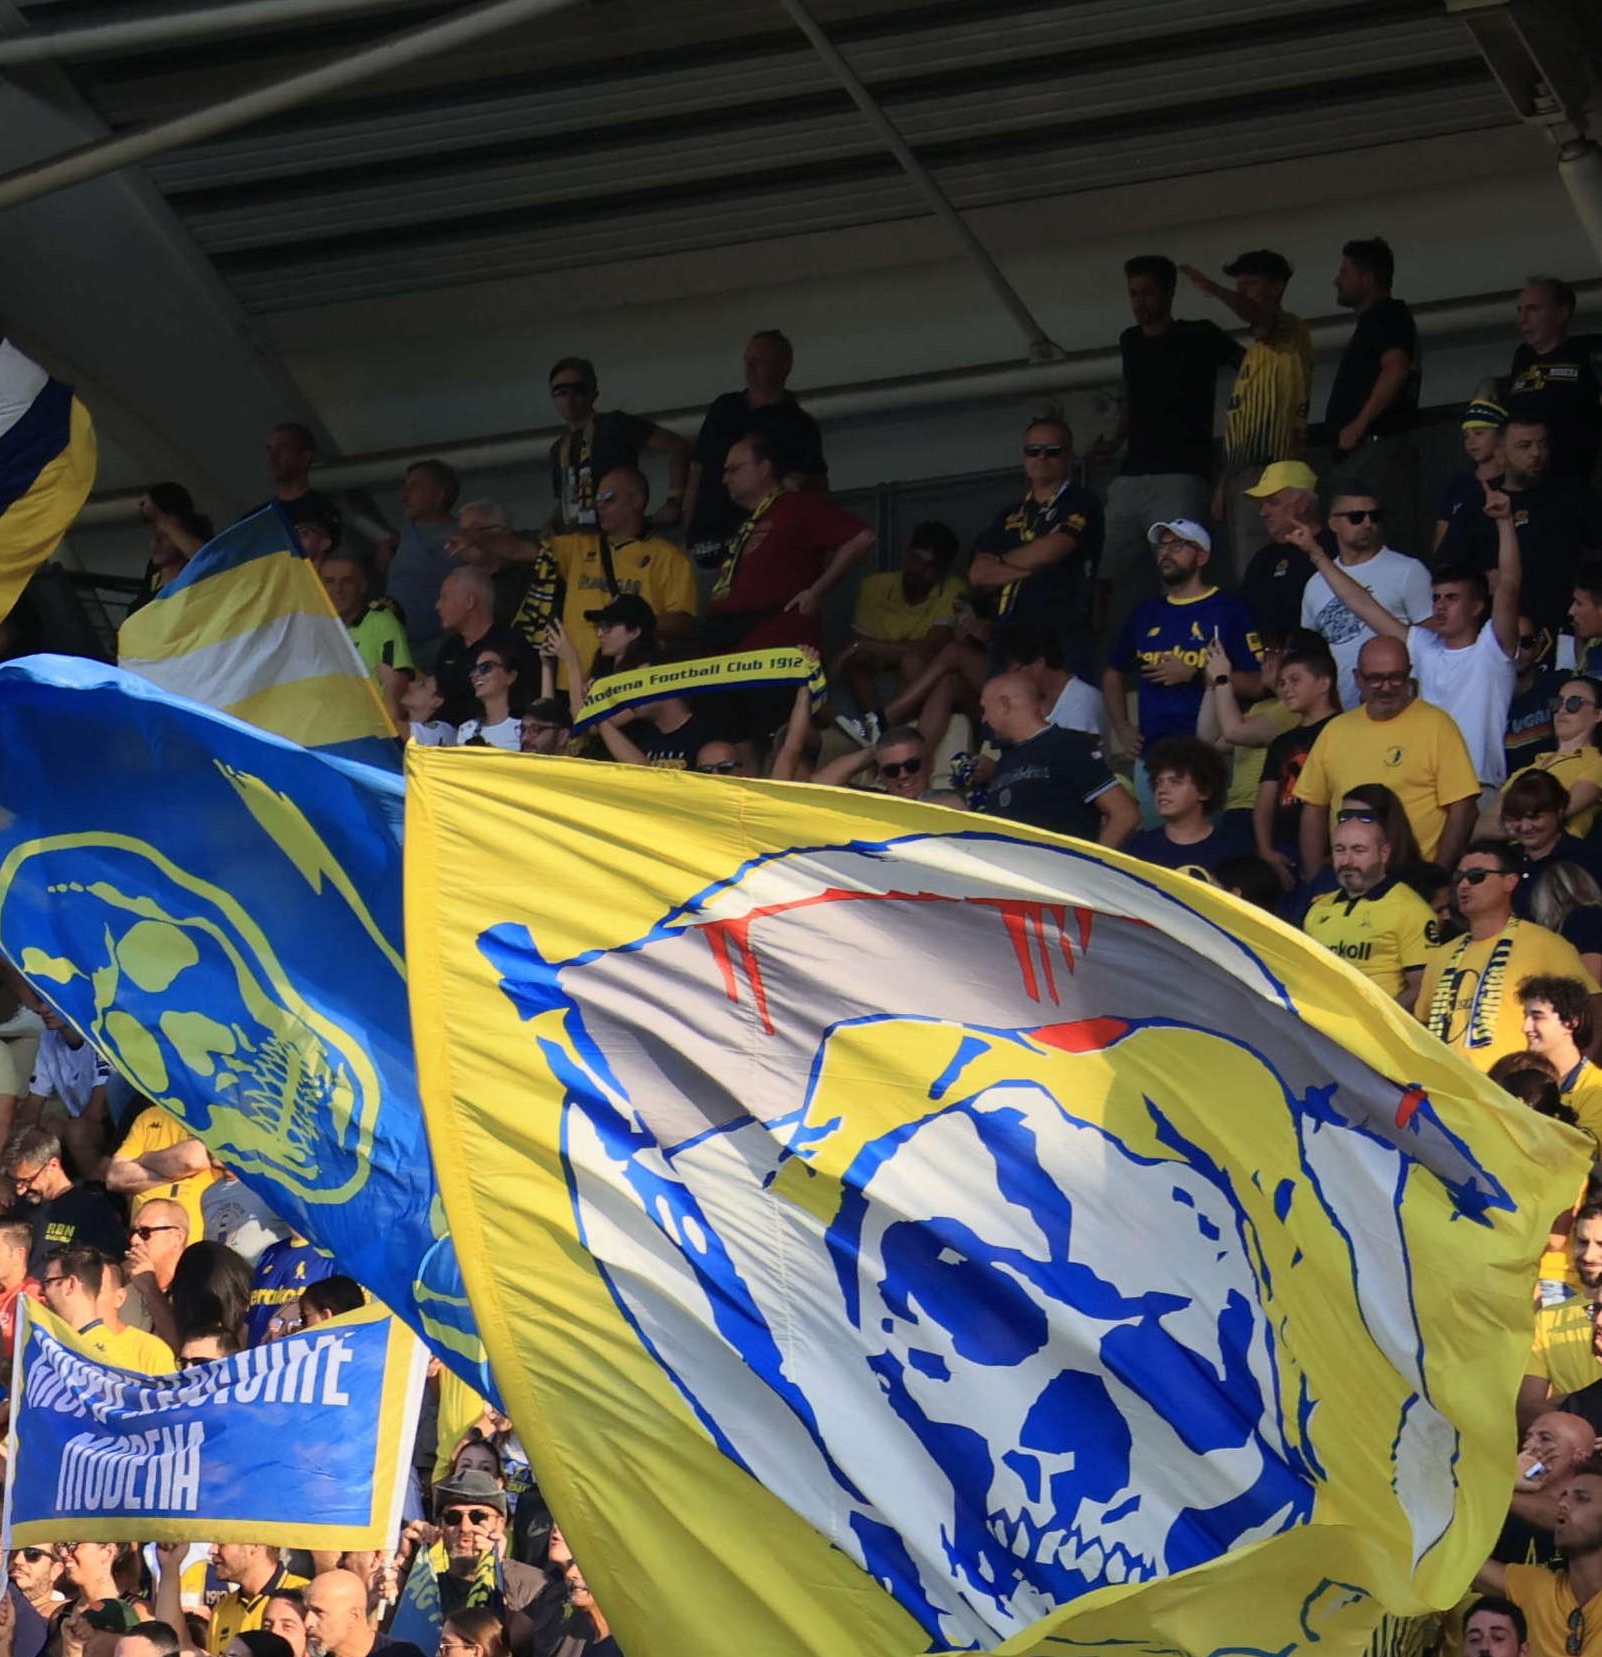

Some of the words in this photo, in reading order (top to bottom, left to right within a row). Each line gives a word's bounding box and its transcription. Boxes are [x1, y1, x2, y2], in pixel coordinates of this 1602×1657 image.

[649, 662, 721, 687] Football
[727, 659, 763, 675] Club
[770, 656, 804, 670] 1912
[55, 1420, 205, 1512] MODENA
